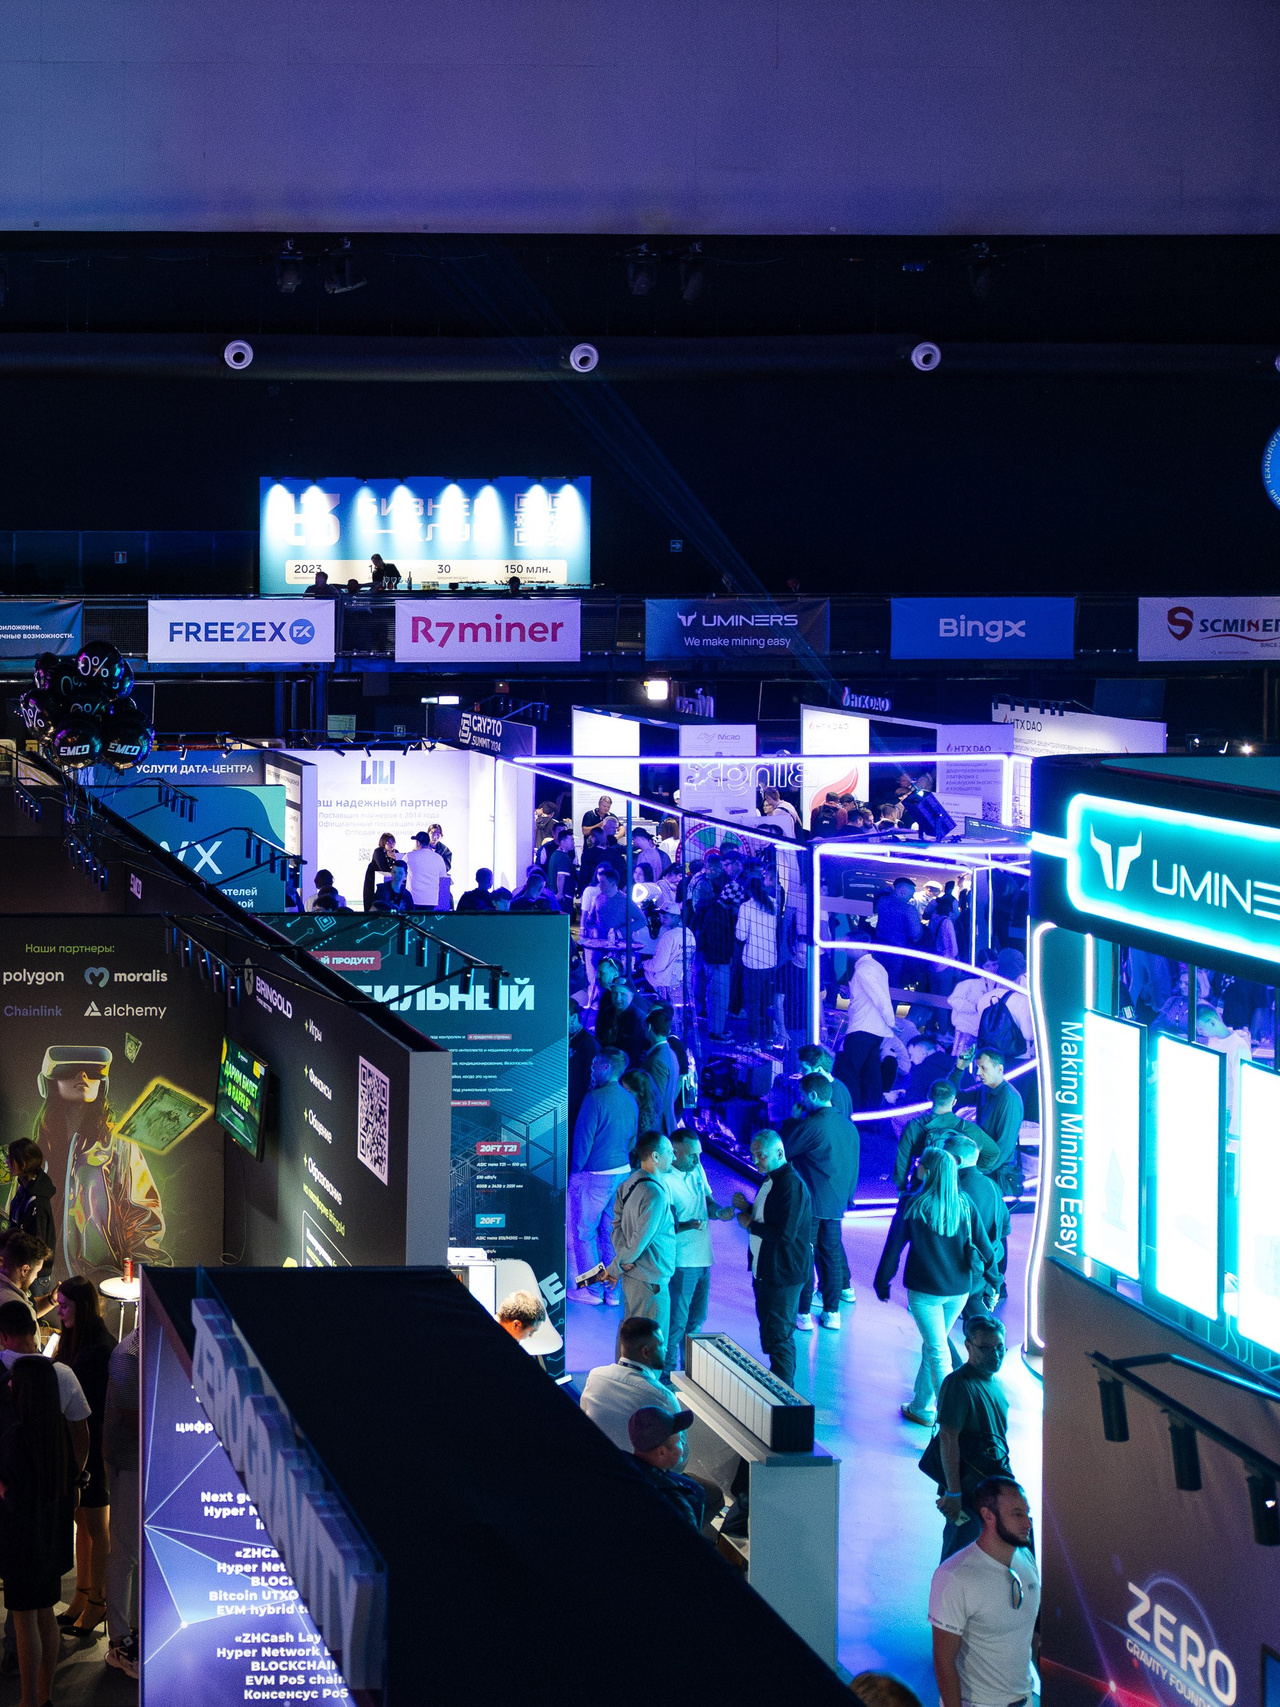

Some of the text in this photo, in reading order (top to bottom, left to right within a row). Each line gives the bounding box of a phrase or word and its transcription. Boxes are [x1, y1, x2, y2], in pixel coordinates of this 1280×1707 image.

[293, 564, 322, 574] 2023
[437, 564, 451, 574] 30
[504, 564, 551, 574] 150 млн.
[702, 614, 798, 627] UMINERS
[22, 632, 74, 640] возможности.
[169, 621, 286, 642] FREE2EX
[411, 614, 564, 648] R7miner
[684, 637, 791, 648] We make mining easy
[79, 655, 110, 678] 0%
[472, 715, 502, 737] CRYPTO
[1026, 720, 1042, 732] DAO
[472, 736, 490, 749] SUMMIT
[136, 763, 254, 775] УСЛУГИ ДАТА-ЦЕНТРА
[336, 797, 448, 809] надежный партнер
[318, 812, 359, 820] Поставщик
[318, 821, 372, 829] Официальный
[221, 887, 258, 897] ателей
[25, 944, 115, 955] Наши партнеры:
[332, 957, 375, 966] ПРОДУКТ
[2, 968, 65, 985] polygon
[114, 969, 168, 982] moralis
[256, 976, 293, 1019] BRINGOLD
[356, 977, 535, 1012] ИЛЬНЫЙ
[4, 1005, 63, 1017] Chainlink
[104, 1004, 167, 1019] alchemy
[309, 1018, 322, 1042] Игры
[308, 1067, 332, 1101] Финансы
[308, 1109, 332, 1144] Общение
[1054, 1021, 1083, 1256] Making Mining Easy
[480, 1217, 502, 1225] 20FT
[201, 1492, 233, 1503] Next
[204, 1506, 245, 1518] Hyper
[217, 1563, 286, 1574] Hyper Net
[209, 1590, 299, 1601] Bitcoin UTXO
[217, 1604, 294, 1617] EVM hybrid
[234, 1632, 322, 1645] «ZHCash Lay
[1127, 1580, 1237, 1707] ZERO
[217, 1647, 320, 1659] Hyper Network
[1126, 1638, 1211, 1707] GRAVITY FOUND
[245, 1675, 275, 1685] EVM
[280, 1675, 305, 1685] PoS
[244, 1689, 349, 1702] Консенсус PoS
